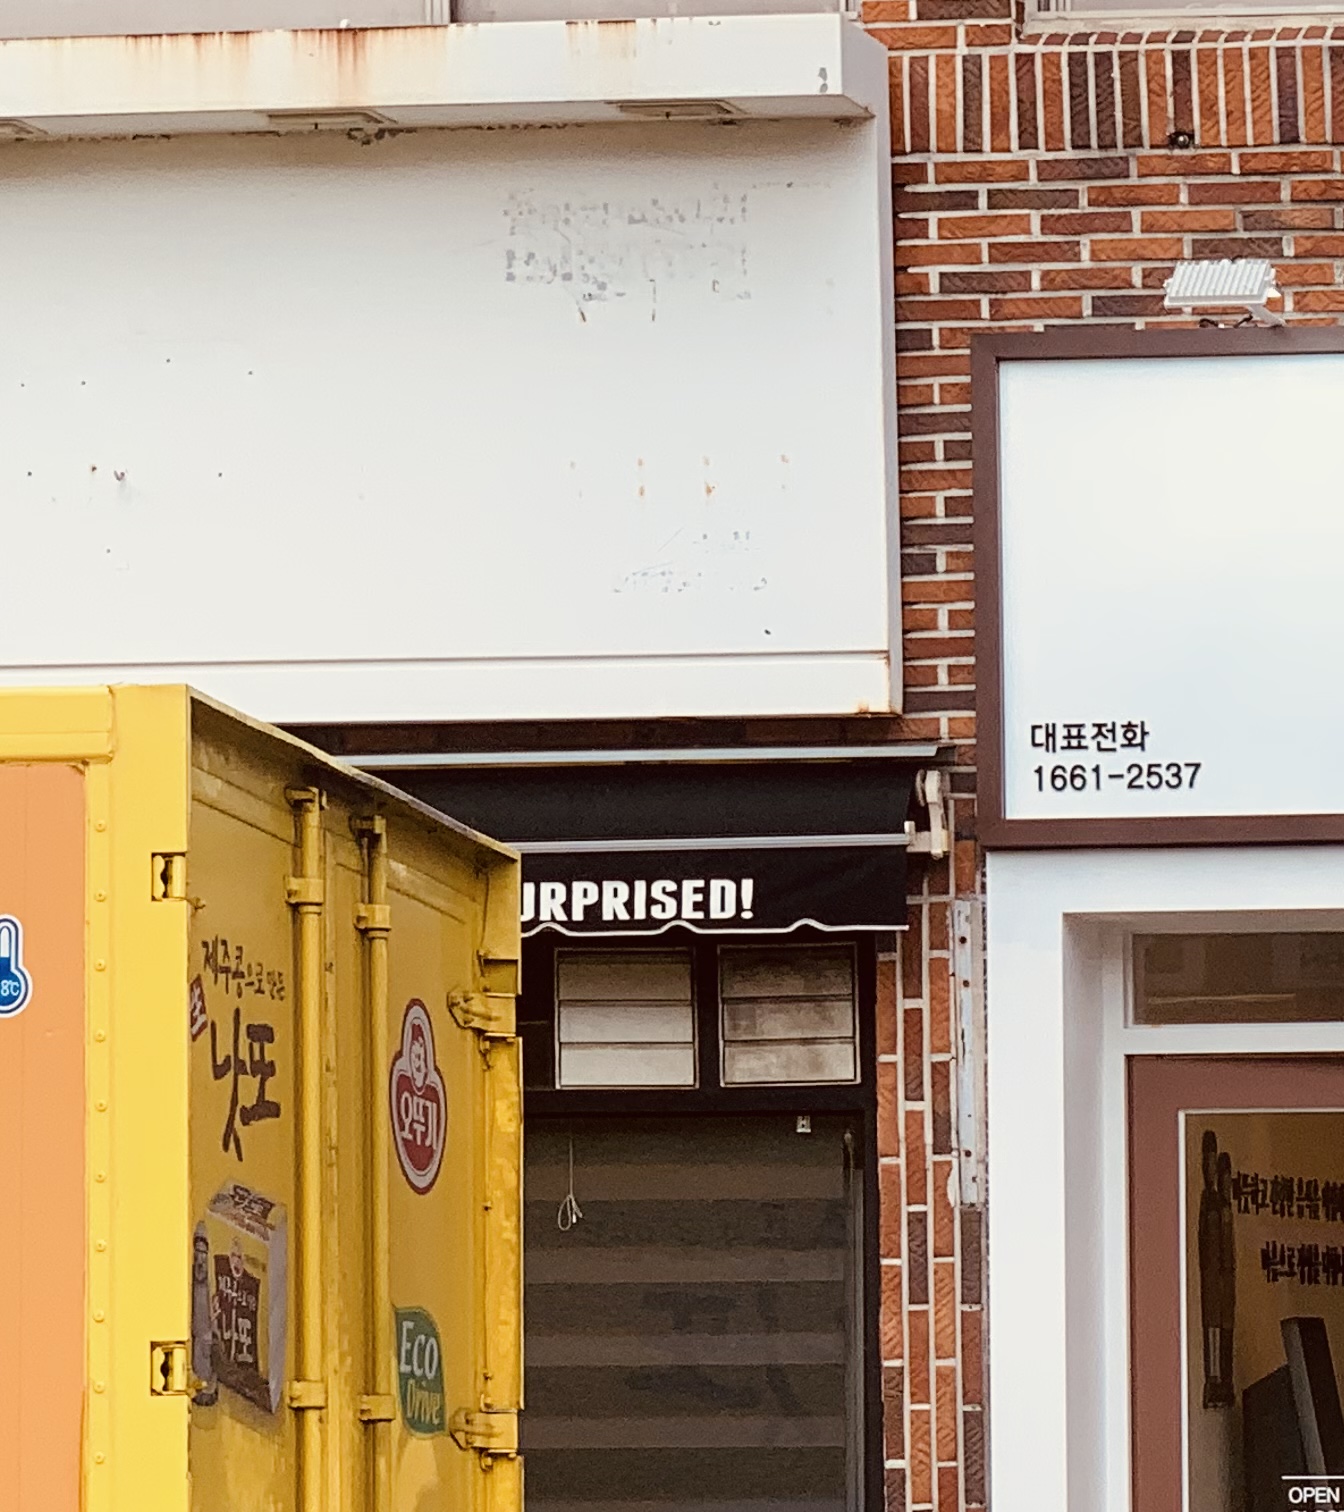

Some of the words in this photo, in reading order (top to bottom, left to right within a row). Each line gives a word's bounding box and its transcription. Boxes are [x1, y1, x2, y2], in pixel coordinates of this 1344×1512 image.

[1030, 720, 1150, 753] 대표전화
[1033, 762, 1202, 792] 1661-2537
[401, 1092, 437, 1150] 오뚜기
[401, 1322, 438, 1379] Eco
[407, 1379, 440, 1424] Drive
[1288, 1487, 1340, 1503] OPEN
